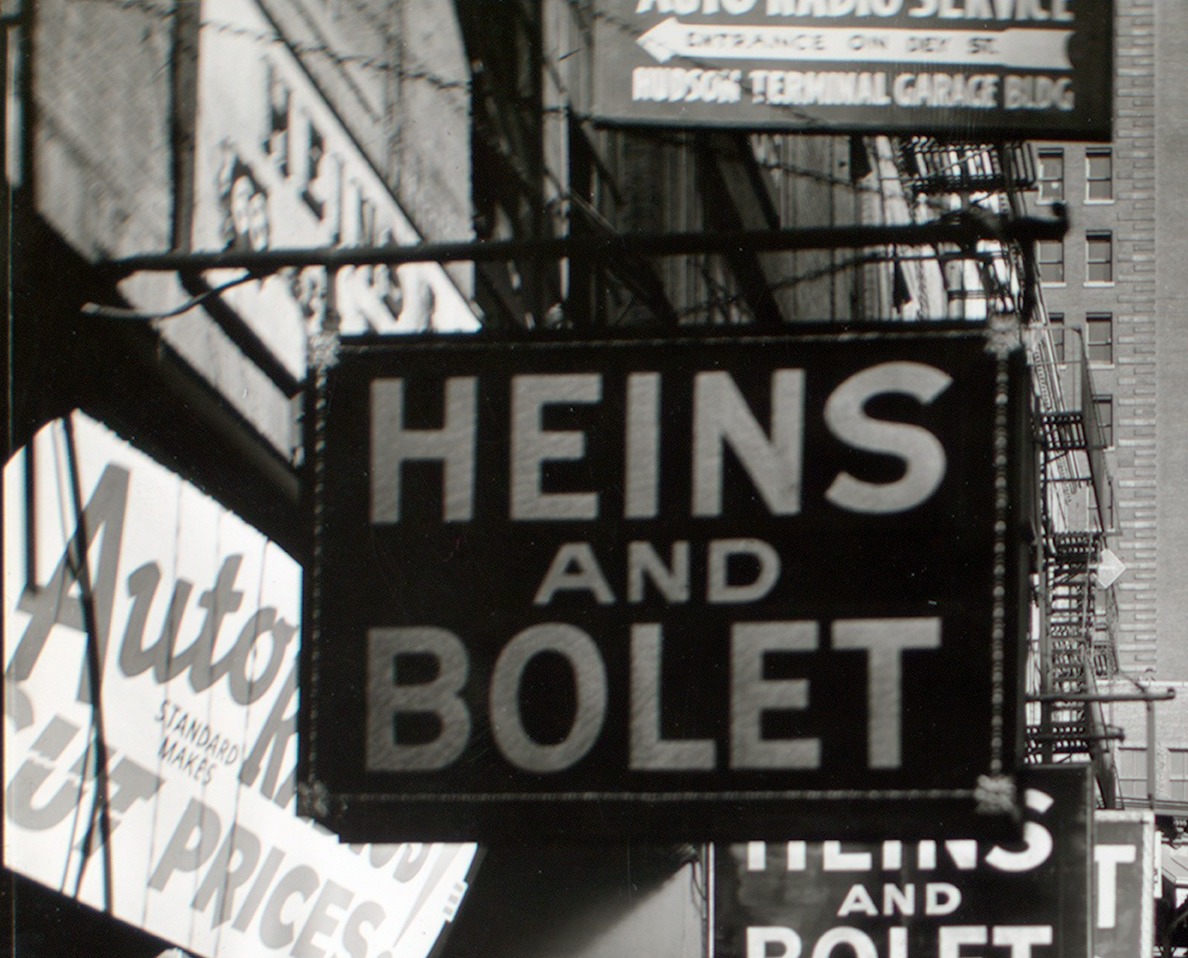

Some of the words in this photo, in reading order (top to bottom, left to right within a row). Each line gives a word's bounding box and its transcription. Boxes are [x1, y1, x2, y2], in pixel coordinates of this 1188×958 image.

[632, 67, 742, 103] HUDSON
[748, 69, 891, 105] TERMINAL
[893, 72, 1000, 107] GARAGE
[370, 361, 954, 524] HEINS
[532, 537, 782, 605] AND
[365, 617, 942, 773] BOLET
[154, 698, 240, 765] STANDARD
[156, 738, 217, 787] MAKES
[837, 882, 962, 916] AND
